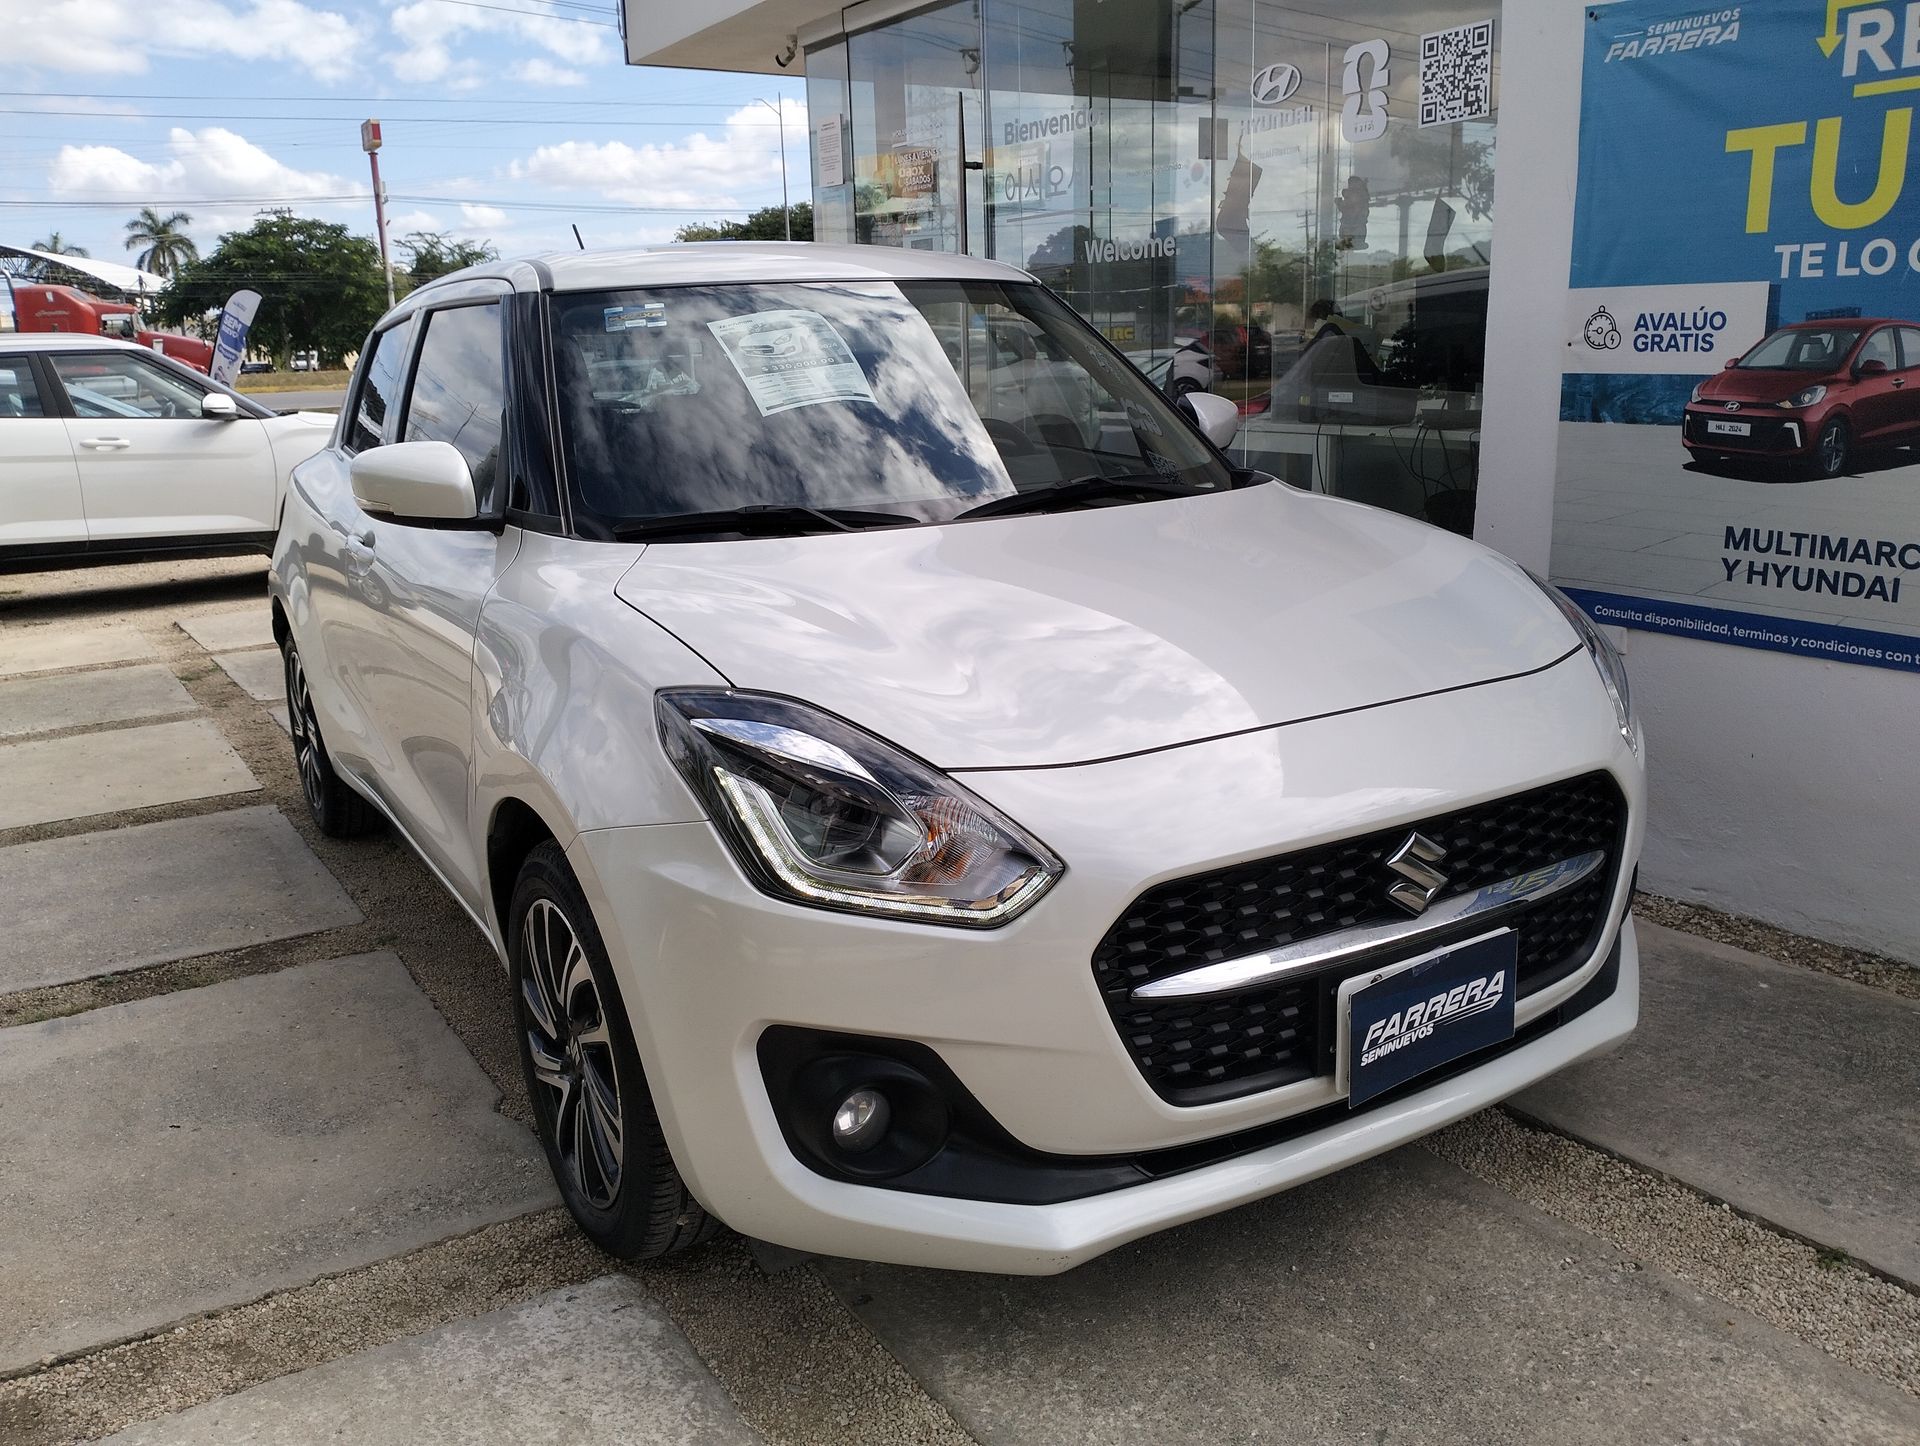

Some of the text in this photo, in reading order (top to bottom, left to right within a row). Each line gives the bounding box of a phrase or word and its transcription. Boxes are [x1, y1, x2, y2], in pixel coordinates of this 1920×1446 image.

[1604, 22, 1740, 63] FARRERA
[1647, 8, 1741, 36] SEMINUEVOS
[1241, 105, 1313, 135] HYUNDAI
[1725, 107, 1913, 234] TU
[1085, 235, 1181, 265] Welcome.
[1775, 242, 1825, 279] TE
[1836, 238, 1896, 276] LO
[1633, 306, 1727, 332] AVALÚO
[1633, 332, 1715, 353] GRATIS
[1724, 526, 1920, 570] MULTIMARC
[1721, 558, 1900, 603] Y HYUNDAI
[1594, 605, 1643, 622] Consulta
[1644, 612, 1731, 637] disponibilidad,
[1733, 626, 1789, 644] terminos
[1790, 636, 1799, 647] y
[1801, 637, 1883, 659] condiciones
[1885, 649, 1911, 663] con
[1362, 970, 1506, 1051] FARRERA
[1360, 1024, 1434, 1067] SEMINUEVOS
